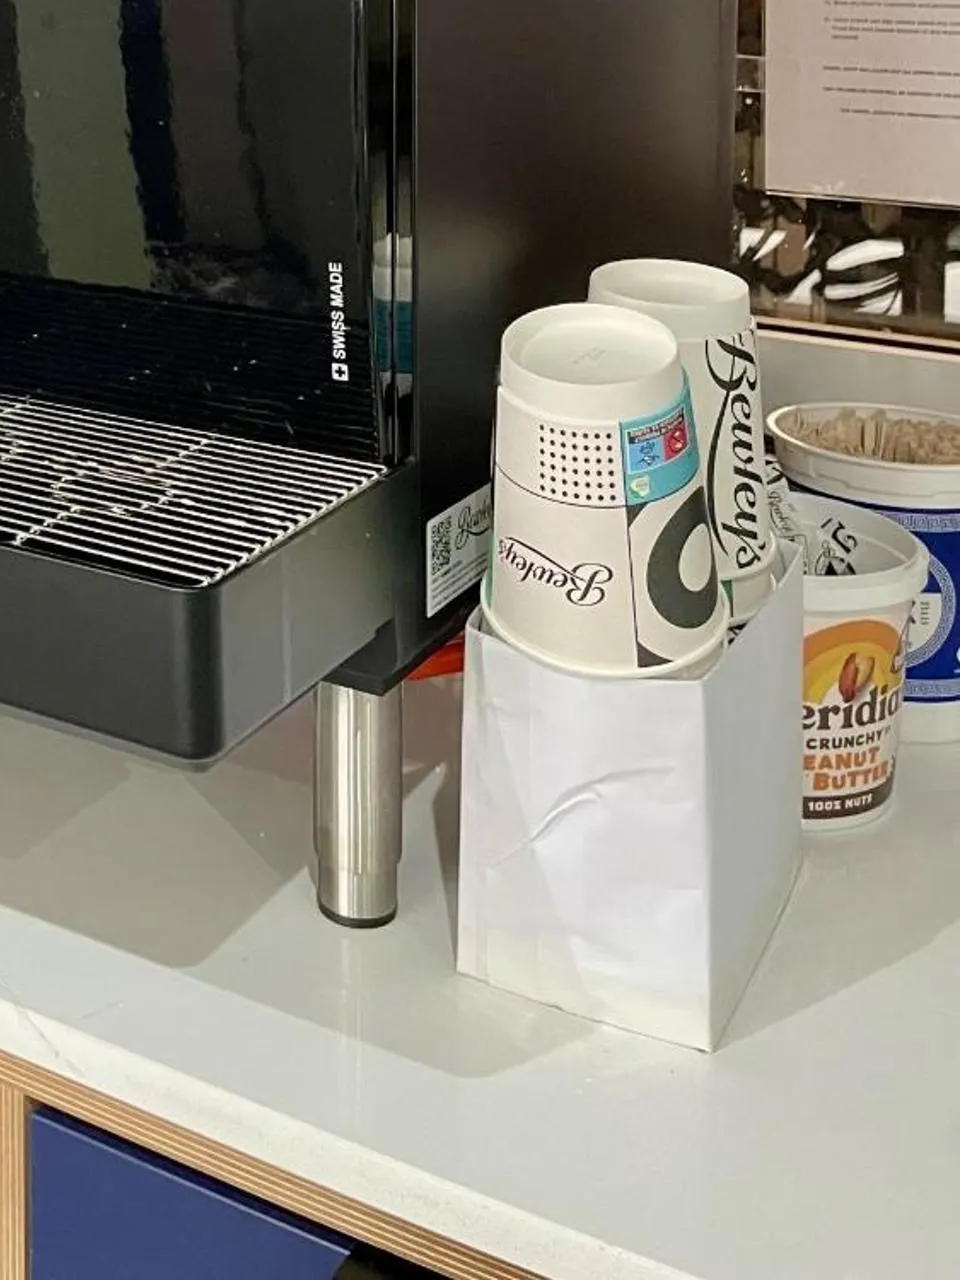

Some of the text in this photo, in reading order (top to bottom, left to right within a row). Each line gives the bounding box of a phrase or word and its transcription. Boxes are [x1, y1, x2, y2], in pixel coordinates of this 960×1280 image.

[327, 261, 347, 360] SWISS MADE
[705, 330, 767, 570] Bewley's
[498, 536, 614, 607] Bewley's
[803, 745, 881, 771] EANUT
[805, 728, 882, 751] CRUNCHY
[844, 793, 873, 809] NUTS
